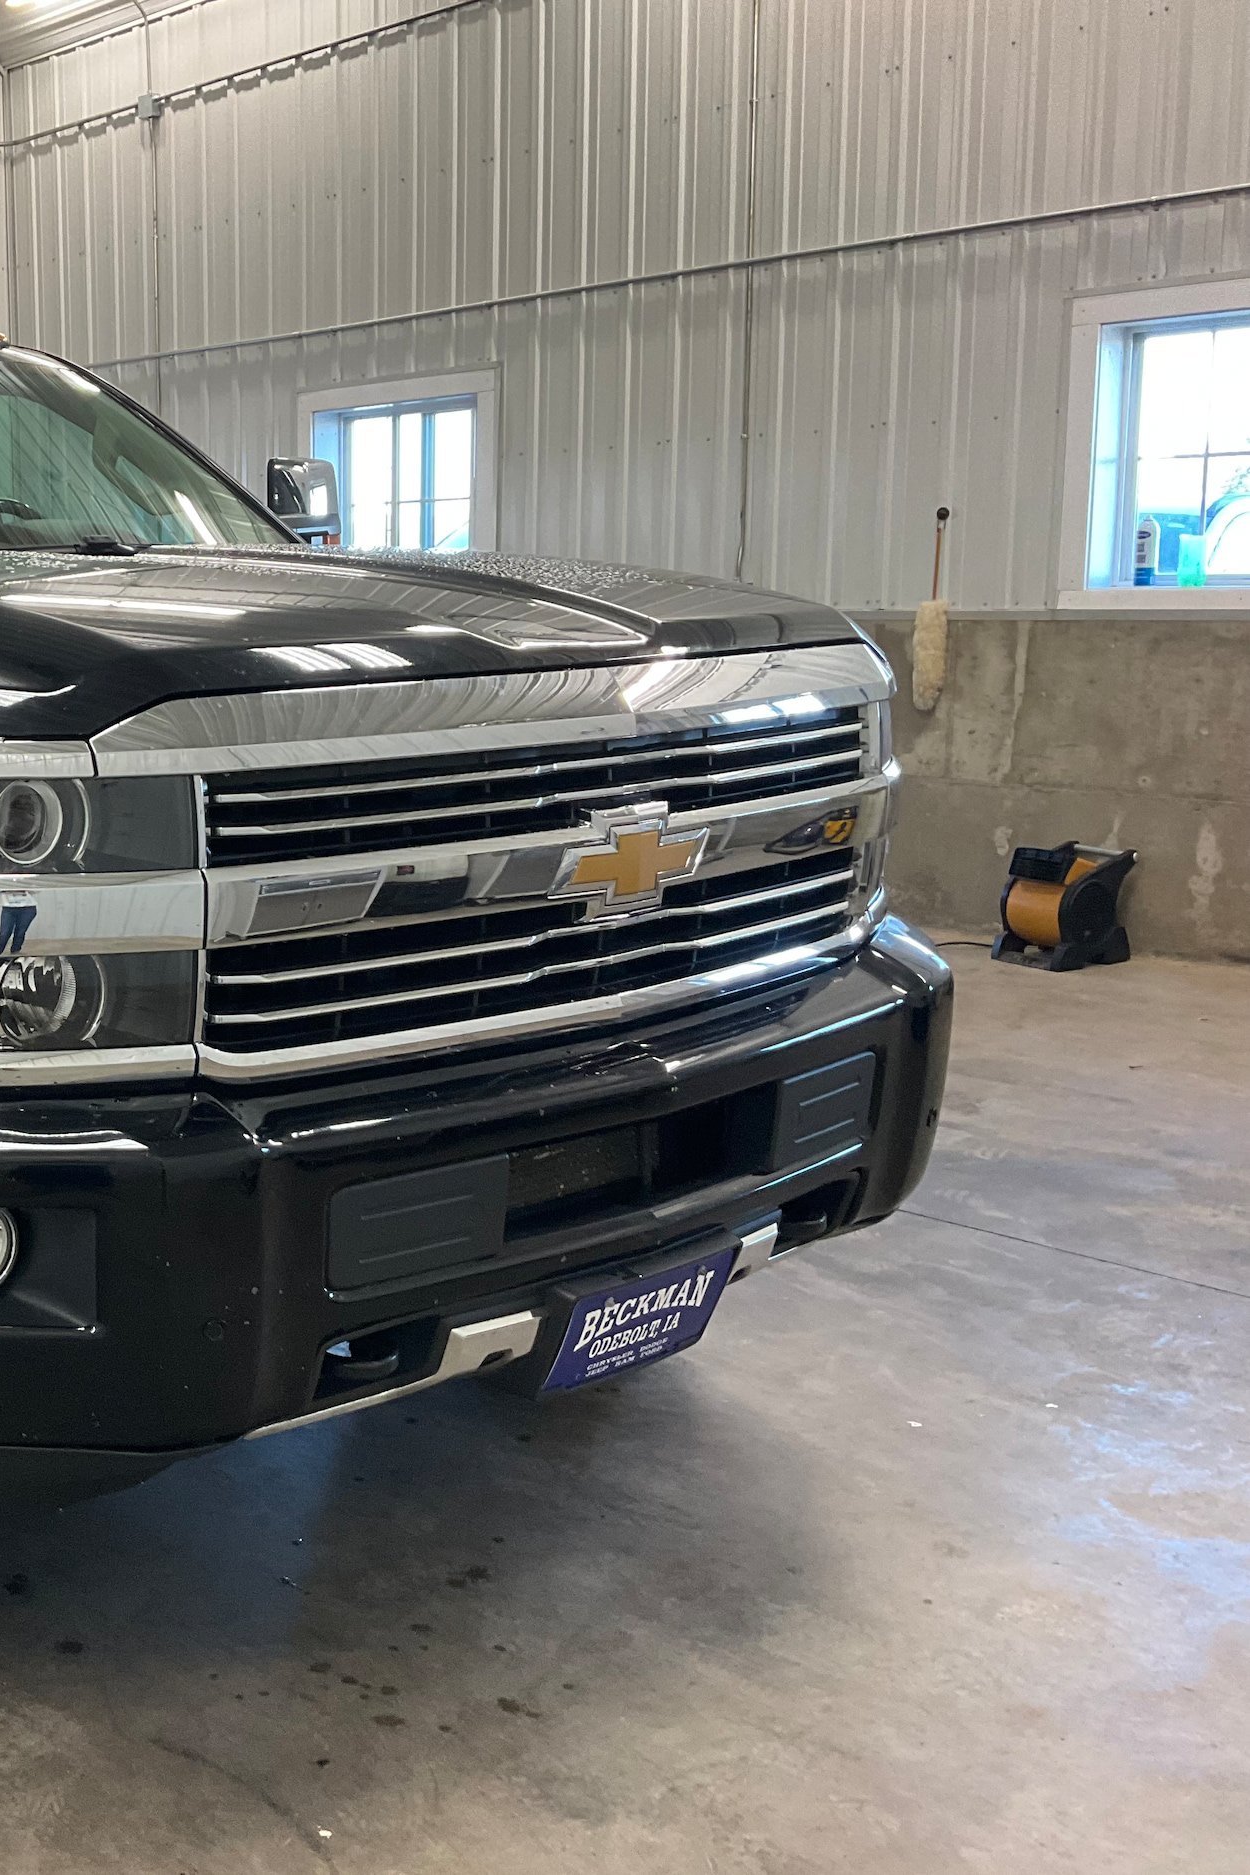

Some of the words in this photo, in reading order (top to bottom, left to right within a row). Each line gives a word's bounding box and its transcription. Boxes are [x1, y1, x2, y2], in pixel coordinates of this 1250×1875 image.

[573, 1270, 715, 1352] BECKMAN
[588, 1319, 661, 1359] ODEBOLT,
[661, 1311, 681, 1334] IA
[584, 1364, 610, 1378] JEEP
[613, 1355, 636, 1368] RAM
[586, 1350, 635, 1371] CHRYSLER
